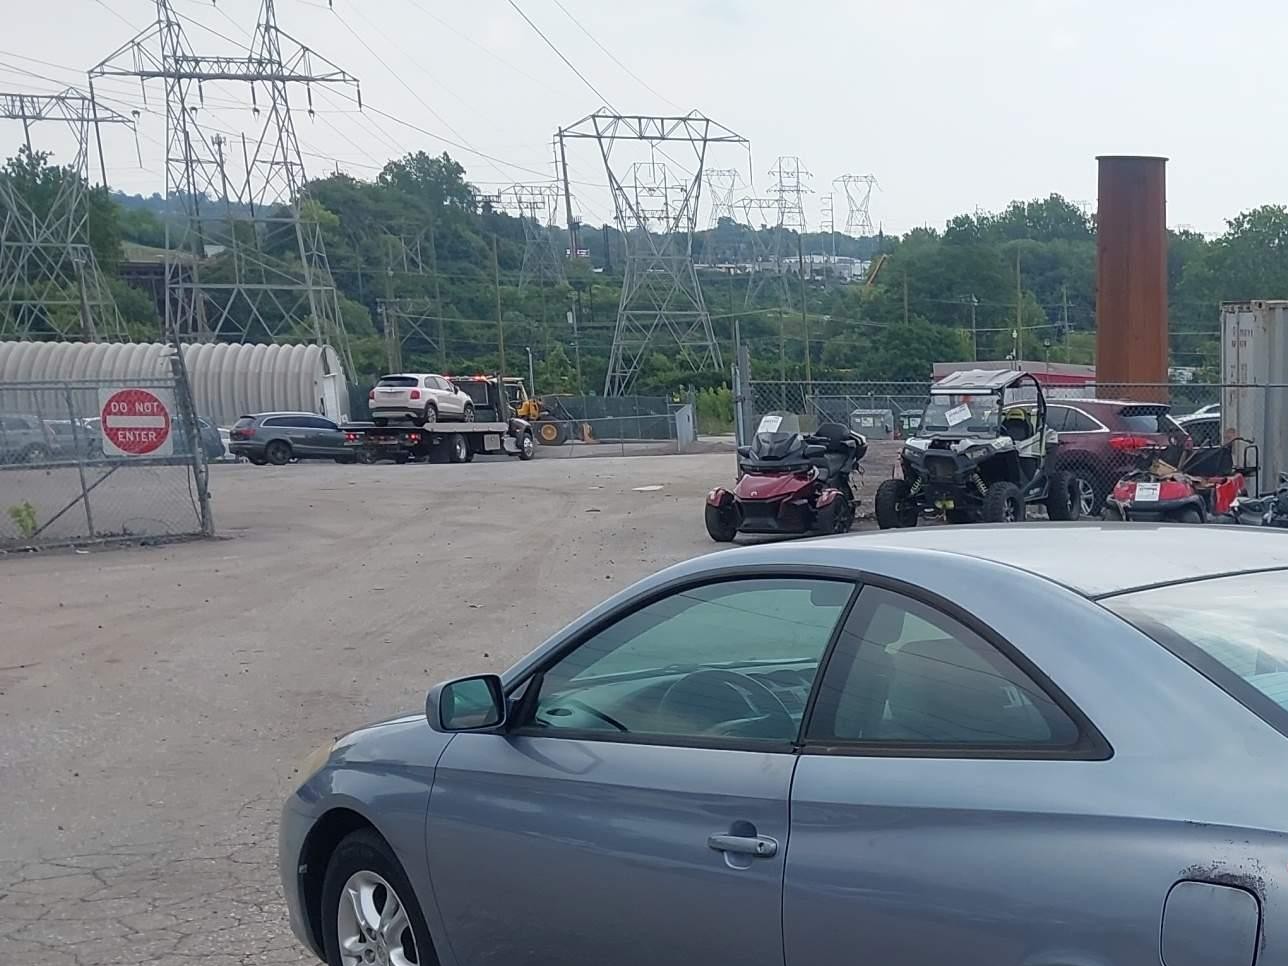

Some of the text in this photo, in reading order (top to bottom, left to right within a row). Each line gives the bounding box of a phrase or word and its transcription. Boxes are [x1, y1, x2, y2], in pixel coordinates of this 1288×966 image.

[111, 402, 159, 413] DO NOT
[118, 431, 157, 441] ENTER
